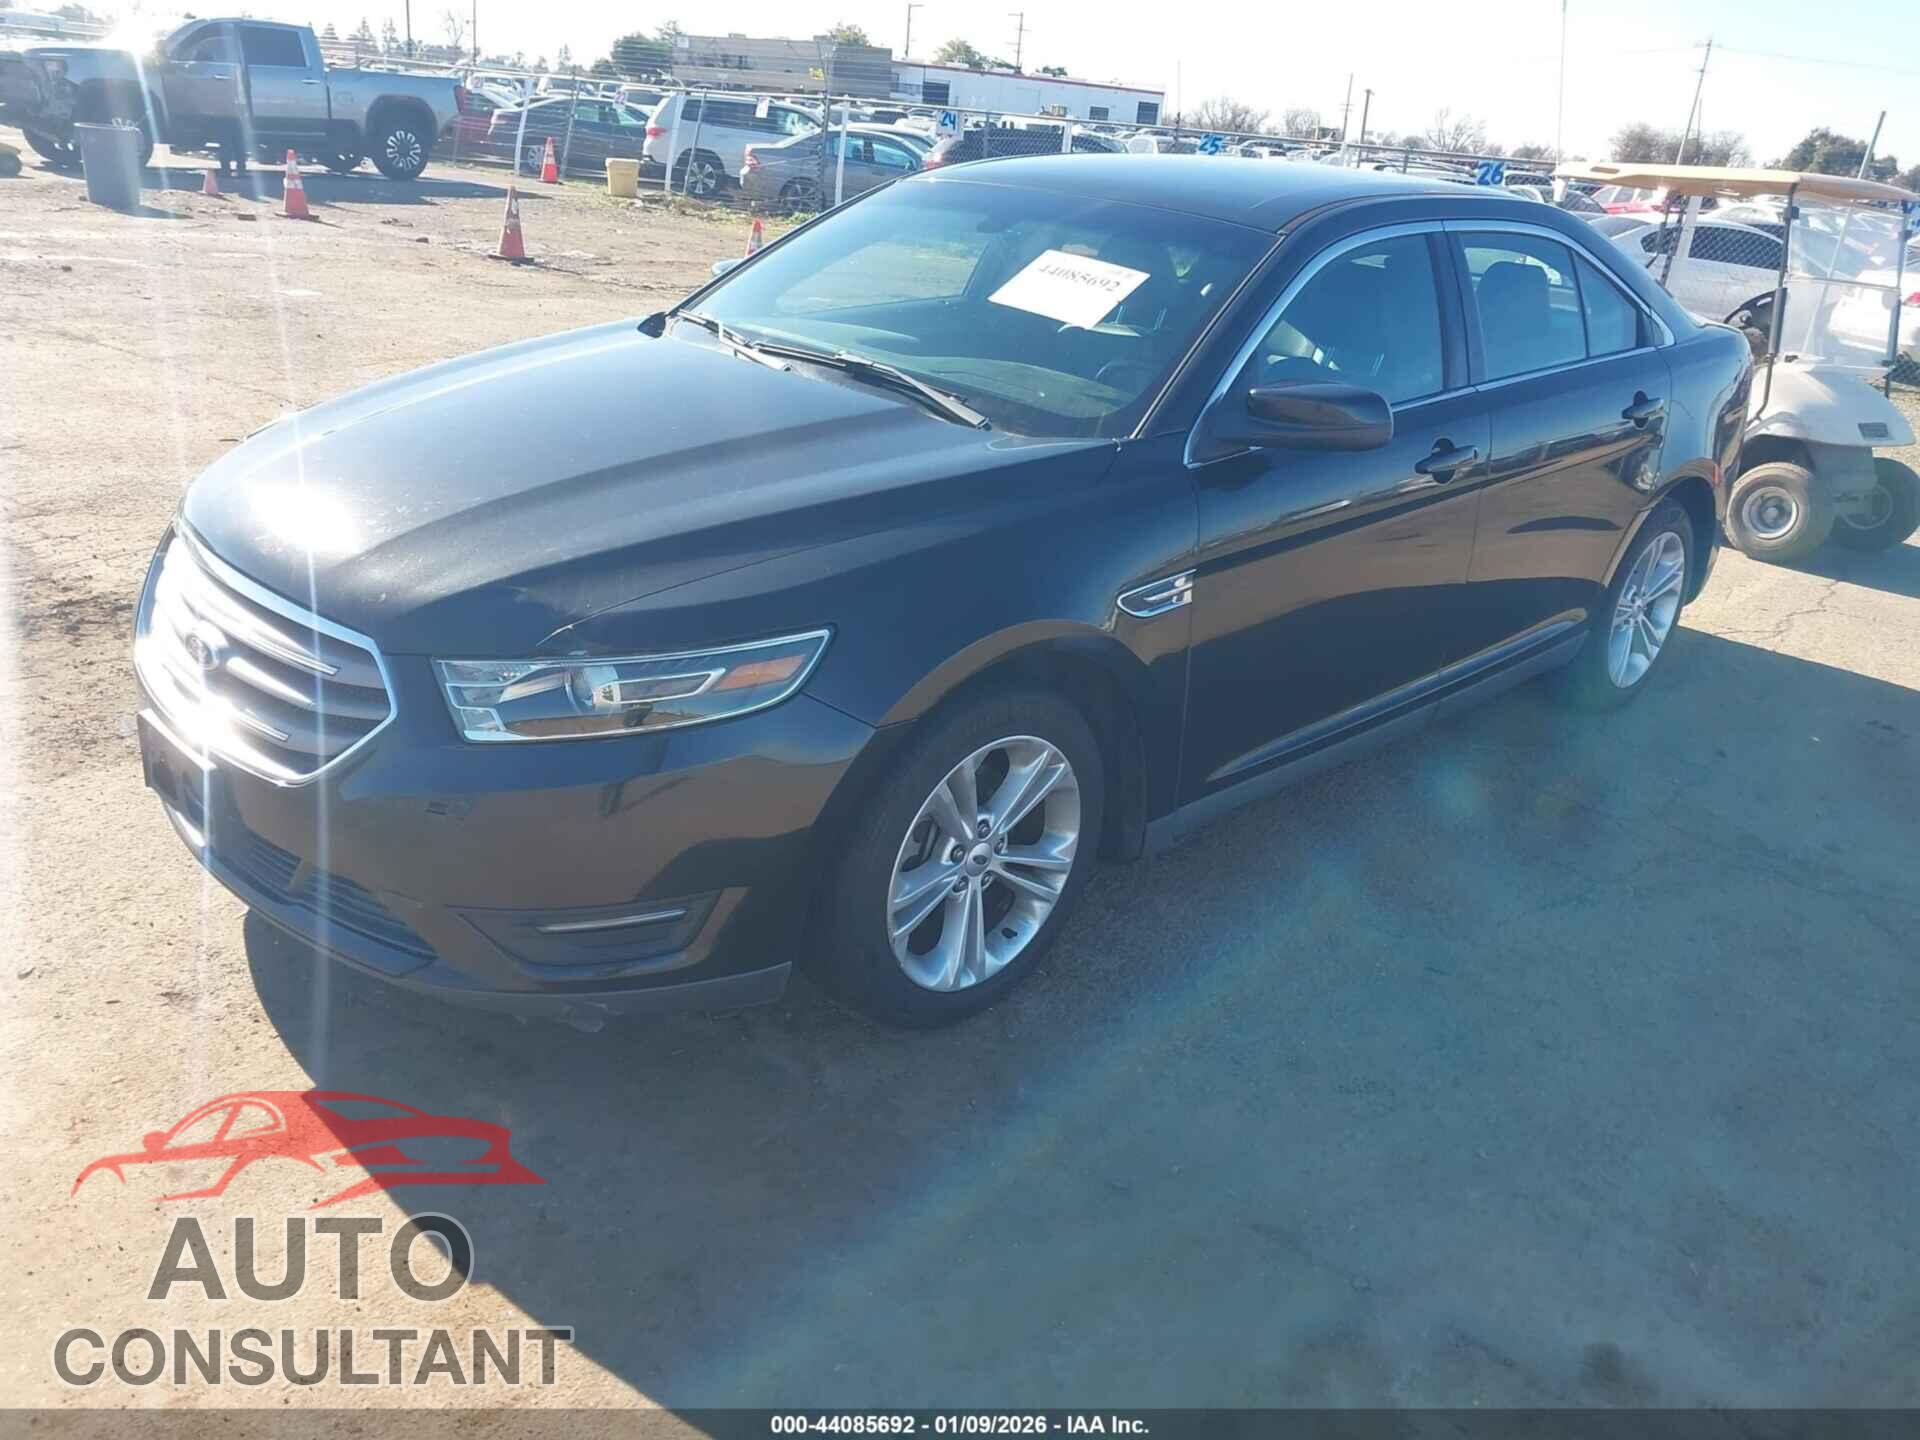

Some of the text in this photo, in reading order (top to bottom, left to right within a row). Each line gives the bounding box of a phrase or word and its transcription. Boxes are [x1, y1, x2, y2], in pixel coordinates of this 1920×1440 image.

[941, 111, 956, 130] 24
[1199, 134, 1222, 155] 25
[1477, 161, 1504, 185] 26
